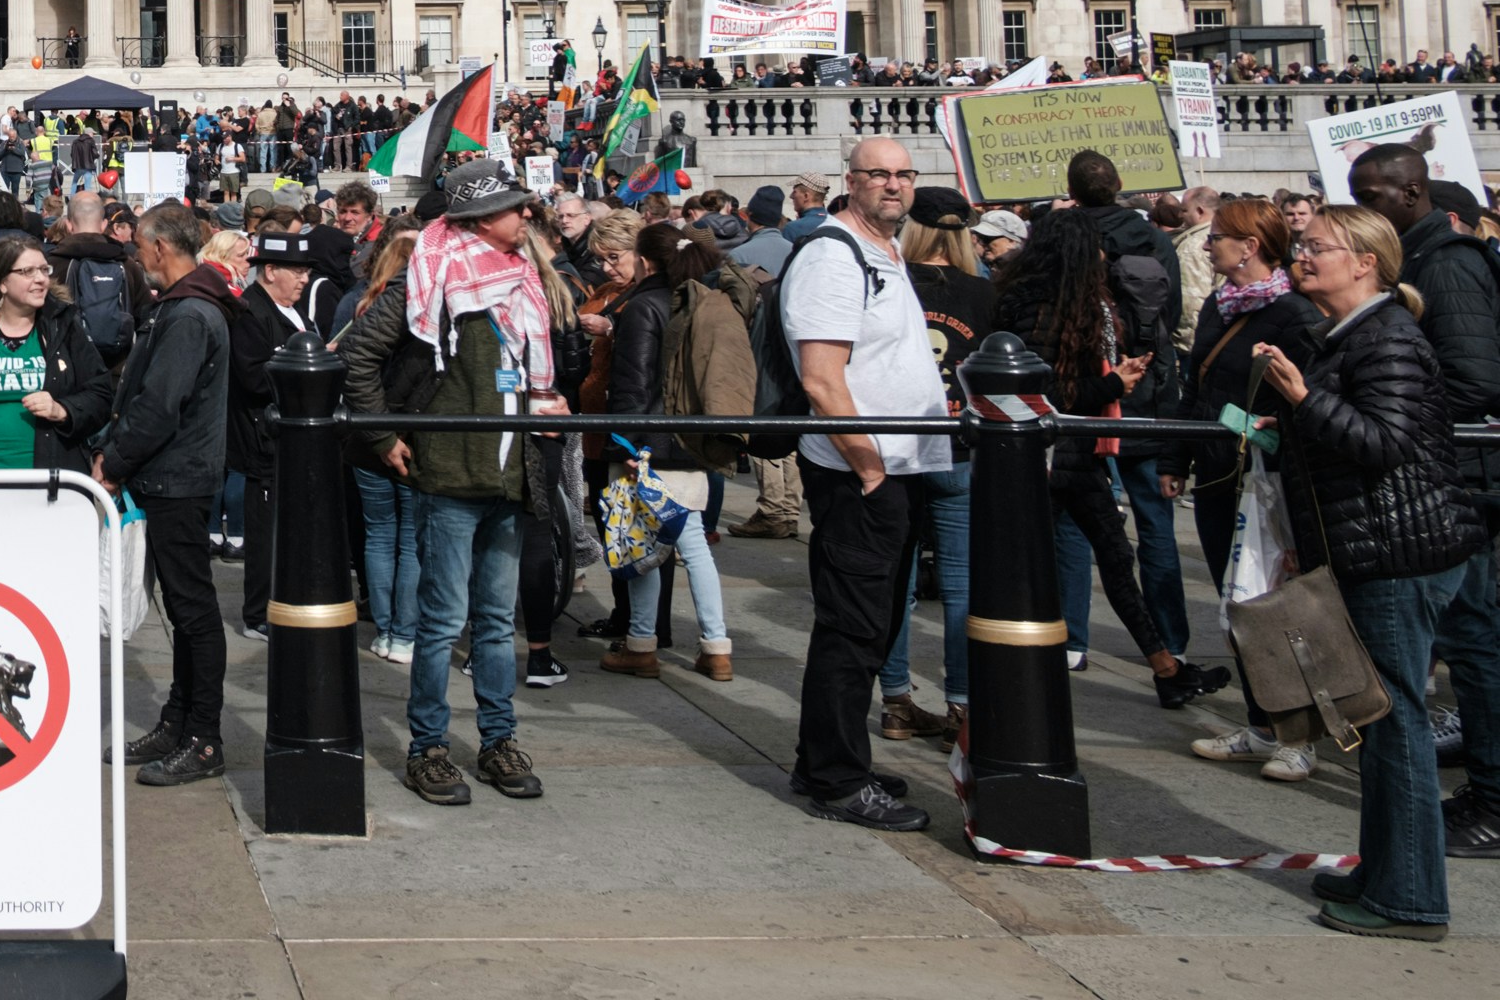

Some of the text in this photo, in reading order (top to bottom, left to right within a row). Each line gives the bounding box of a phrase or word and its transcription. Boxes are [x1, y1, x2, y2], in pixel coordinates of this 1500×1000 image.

[718, 4, 741, 14] GOING
[713, 17, 760, 35] RESEARCH
[807, 13, 835, 29] SHARE
[1173, 66, 1208, 80] QUARANTINE
[1033, 92, 1101, 107] IT'S NOW
[1178, 98, 1212, 115] TYRANNY
[982, 106, 1136, 126] A CONSPIRACY THEORY
[1385, 114, 1397, 129] AT
[1400, 104, 1444, 126] 9:59PM
[977, 119, 1169, 149] TO BELIEVE THAT THE IMMUNE
[982, 152, 1026, 168] SYSTEM
[1030, 150, 1042, 164] IS
[1103, 144, 1118, 157] OF
[1124, 142, 1165, 157] DOING
[371, 177, 388, 186] OATH
[532, 176, 551, 184] TRUTH
[988, 168, 1012, 183] THE
[946, 316, 974, 340] ORDER
